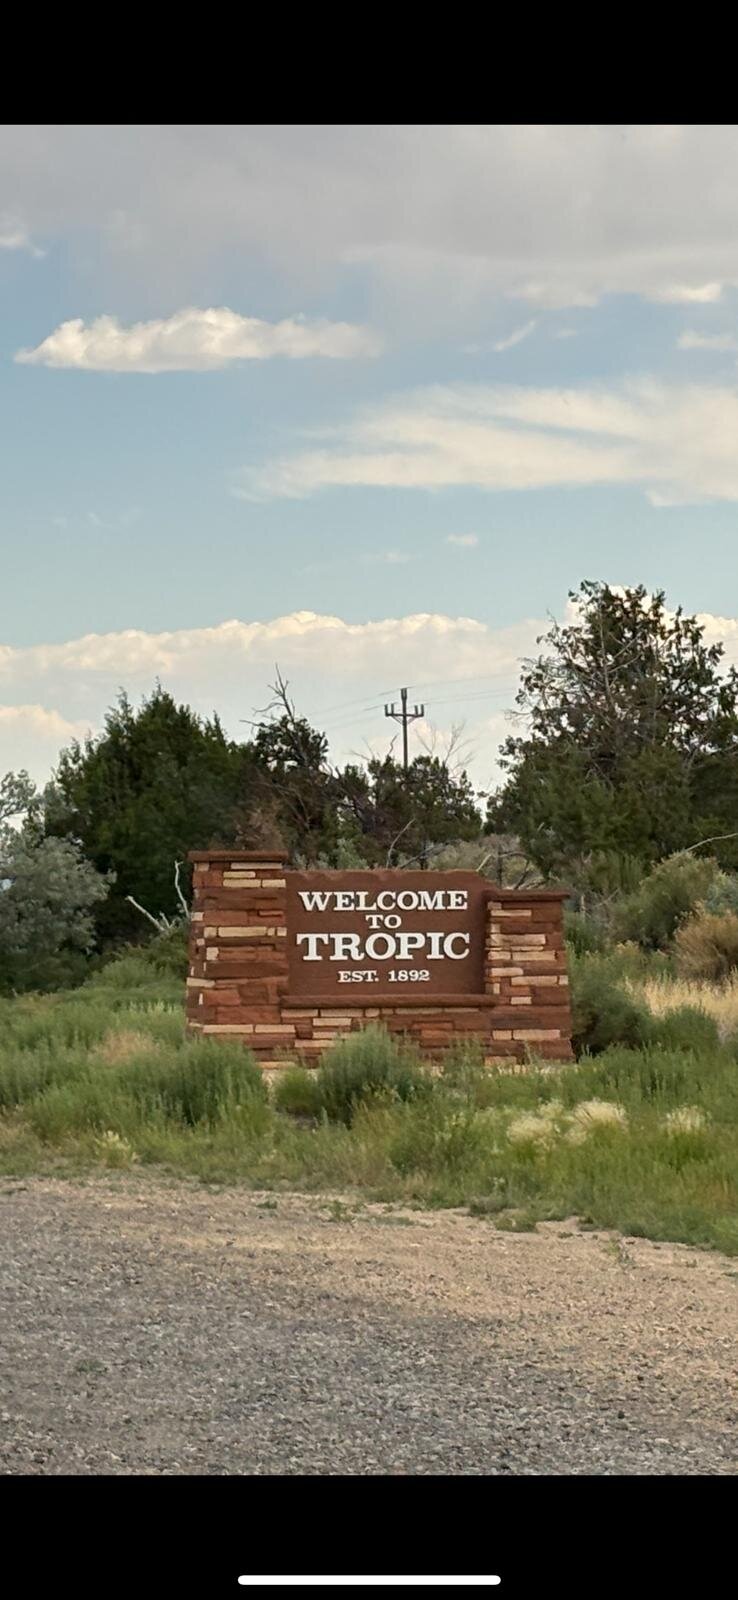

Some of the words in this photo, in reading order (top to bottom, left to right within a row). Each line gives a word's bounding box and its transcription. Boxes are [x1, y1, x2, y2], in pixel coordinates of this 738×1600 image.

[298, 890, 468, 911] WELCOME
[365, 914, 402, 929] TO
[296, 932, 470, 961] TROPIC
[338, 970, 379, 983] EST.
[388, 969, 430, 982] 1892
